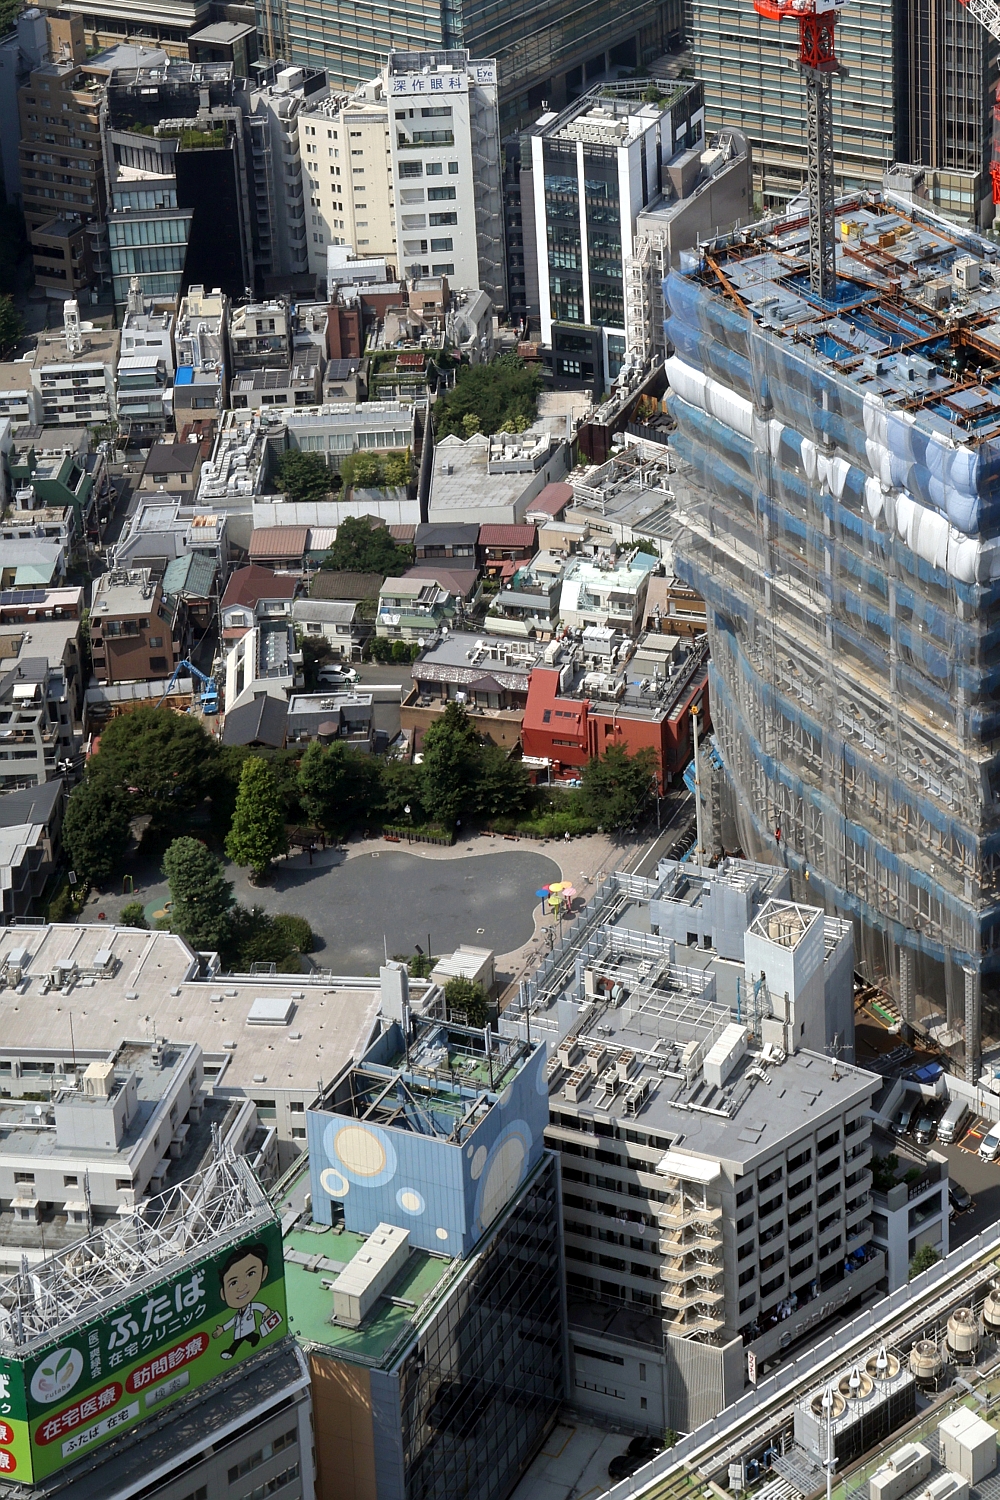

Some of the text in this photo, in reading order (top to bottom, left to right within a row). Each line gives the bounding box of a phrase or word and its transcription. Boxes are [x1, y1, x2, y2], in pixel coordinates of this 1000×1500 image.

[393, 77, 462, 91] 深作眼科
[477, 68, 493, 77] Eye
[107, 1269, 206, 1350] ふたば
[132, 1336, 203, 1389] 訪問診療
[44, 1383, 71, 1401] Futaba
[153, 1377, 182, 1401] 検索
[42, 1386, 116, 1440] 在宅医療
[66, 1409, 129, 1452] ふたば 在宅
